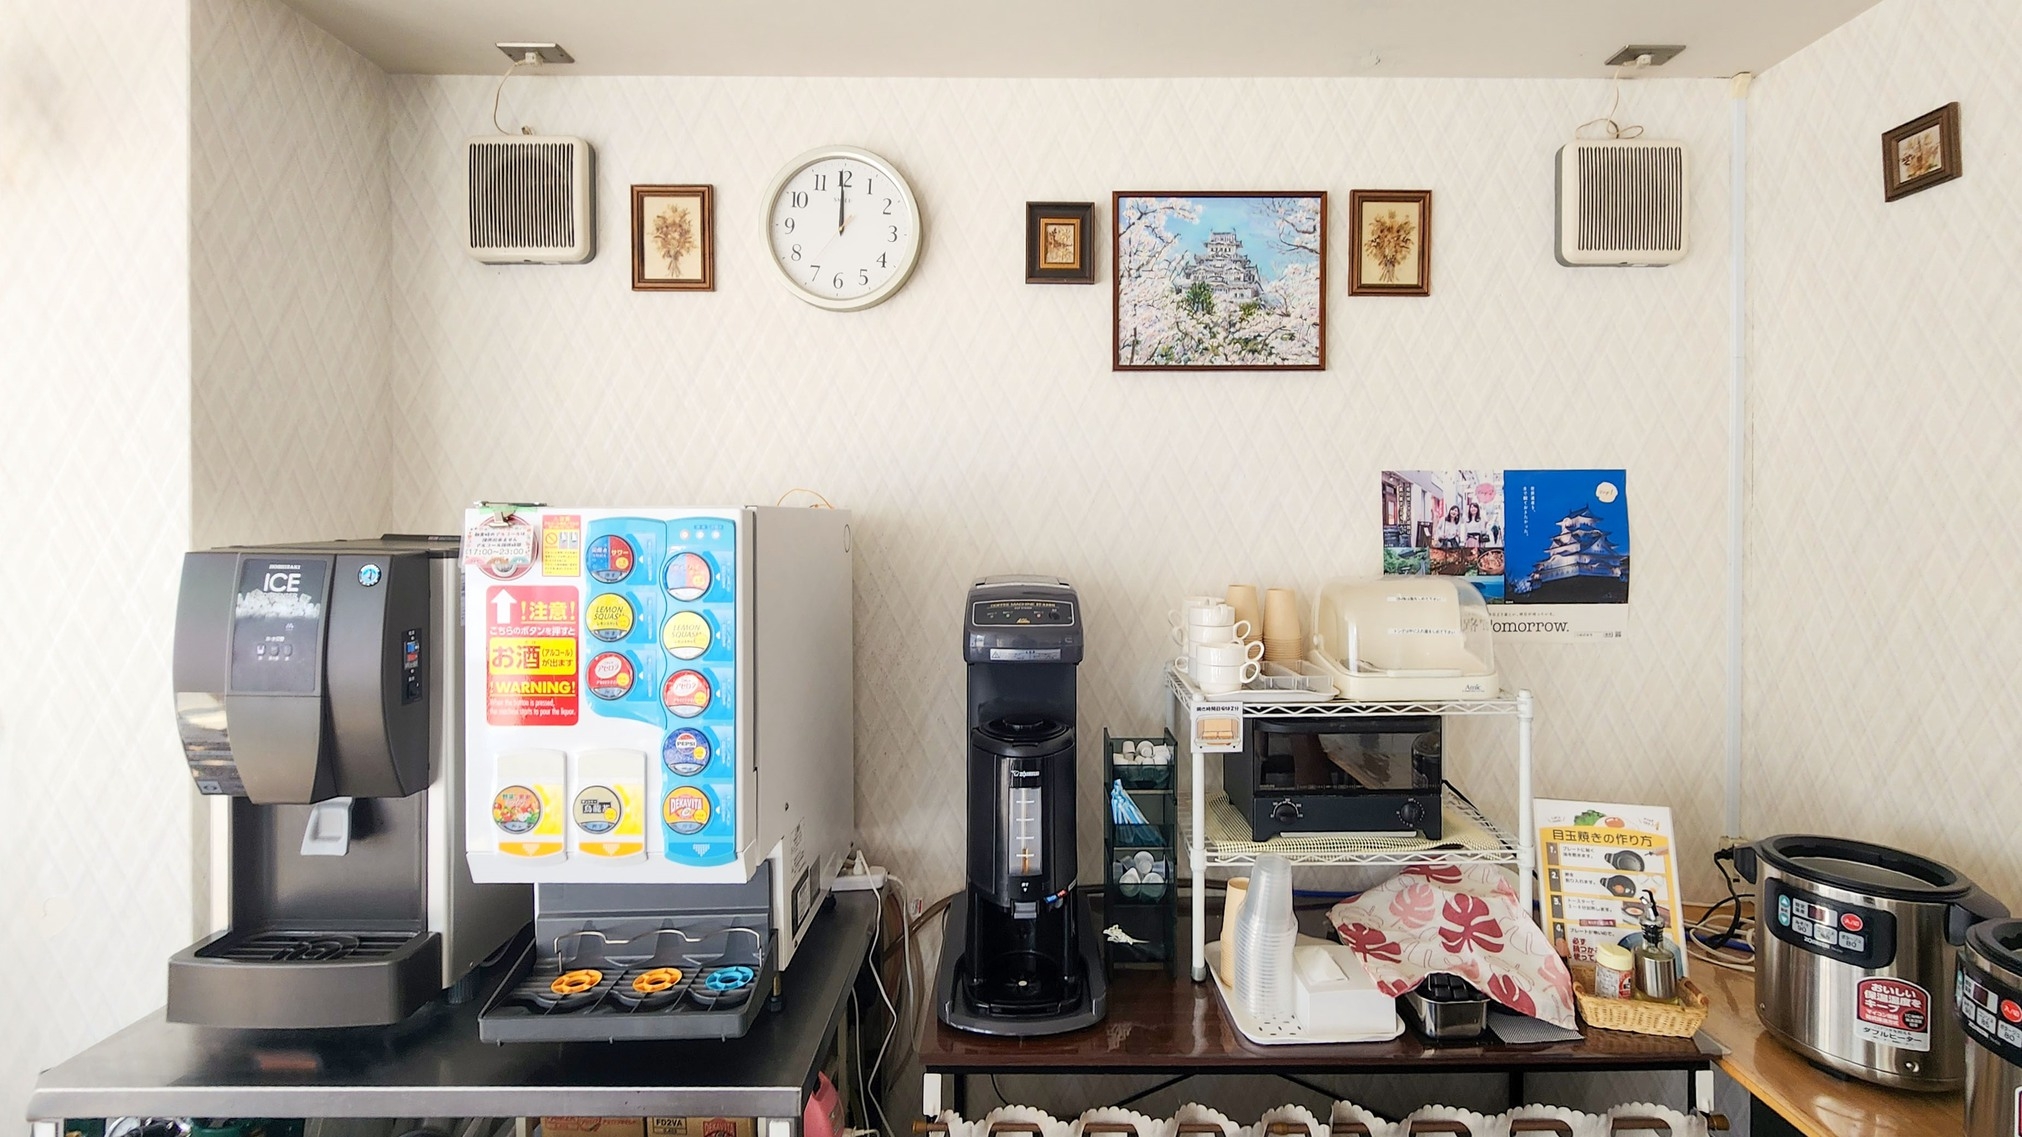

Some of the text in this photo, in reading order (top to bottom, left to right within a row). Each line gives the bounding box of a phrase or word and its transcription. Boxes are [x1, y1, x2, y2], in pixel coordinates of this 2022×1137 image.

[814, 174, 827, 191] 11
[838, 169, 853, 188] 12
[867, 178, 873, 195] 1
[791, 191, 809, 208] 10
[882, 198, 892, 215] 2
[784, 217, 795, 234] 9
[887, 225, 898, 242] 3
[791, 244, 802, 261] 8
[876, 251, 887, 268] 4
[810, 264, 821, 282] 7
[833, 272, 844, 289] 6
[858, 269, 869, 285] 5
[263, 572, 301, 592] ICE
[490, 626, 576, 636] こちらのボタンを押すと
[1490, 619, 1570, 633] omorrow.
[492, 645, 540, 669] お酒
[541, 648, 574, 657] (アルコール)
[542, 659, 573, 667] が出ます
[490, 681, 576, 694] !WARNING!
[535, 698, 555, 708] pressed,
[540, 709, 550, 717] pour
[561, 708, 576, 717] liquor.
[670, 797, 703, 812] DEKAVITA
[1552, 829, 1653, 847] 目玉焼きの作り方
[1551, 871, 1559, 879] 2.
[1553, 897, 1561, 906] 3.
[1572, 937, 1586, 945] 必ず
[1846, 940, 1857, 948] 80
[1871, 983, 1917, 998] おいしい
[1864, 999, 1900, 1013] キープ
[1863, 1027, 1922, 1042] ダブルヒーター
[656, 1119, 683, 1127] FD2VA
